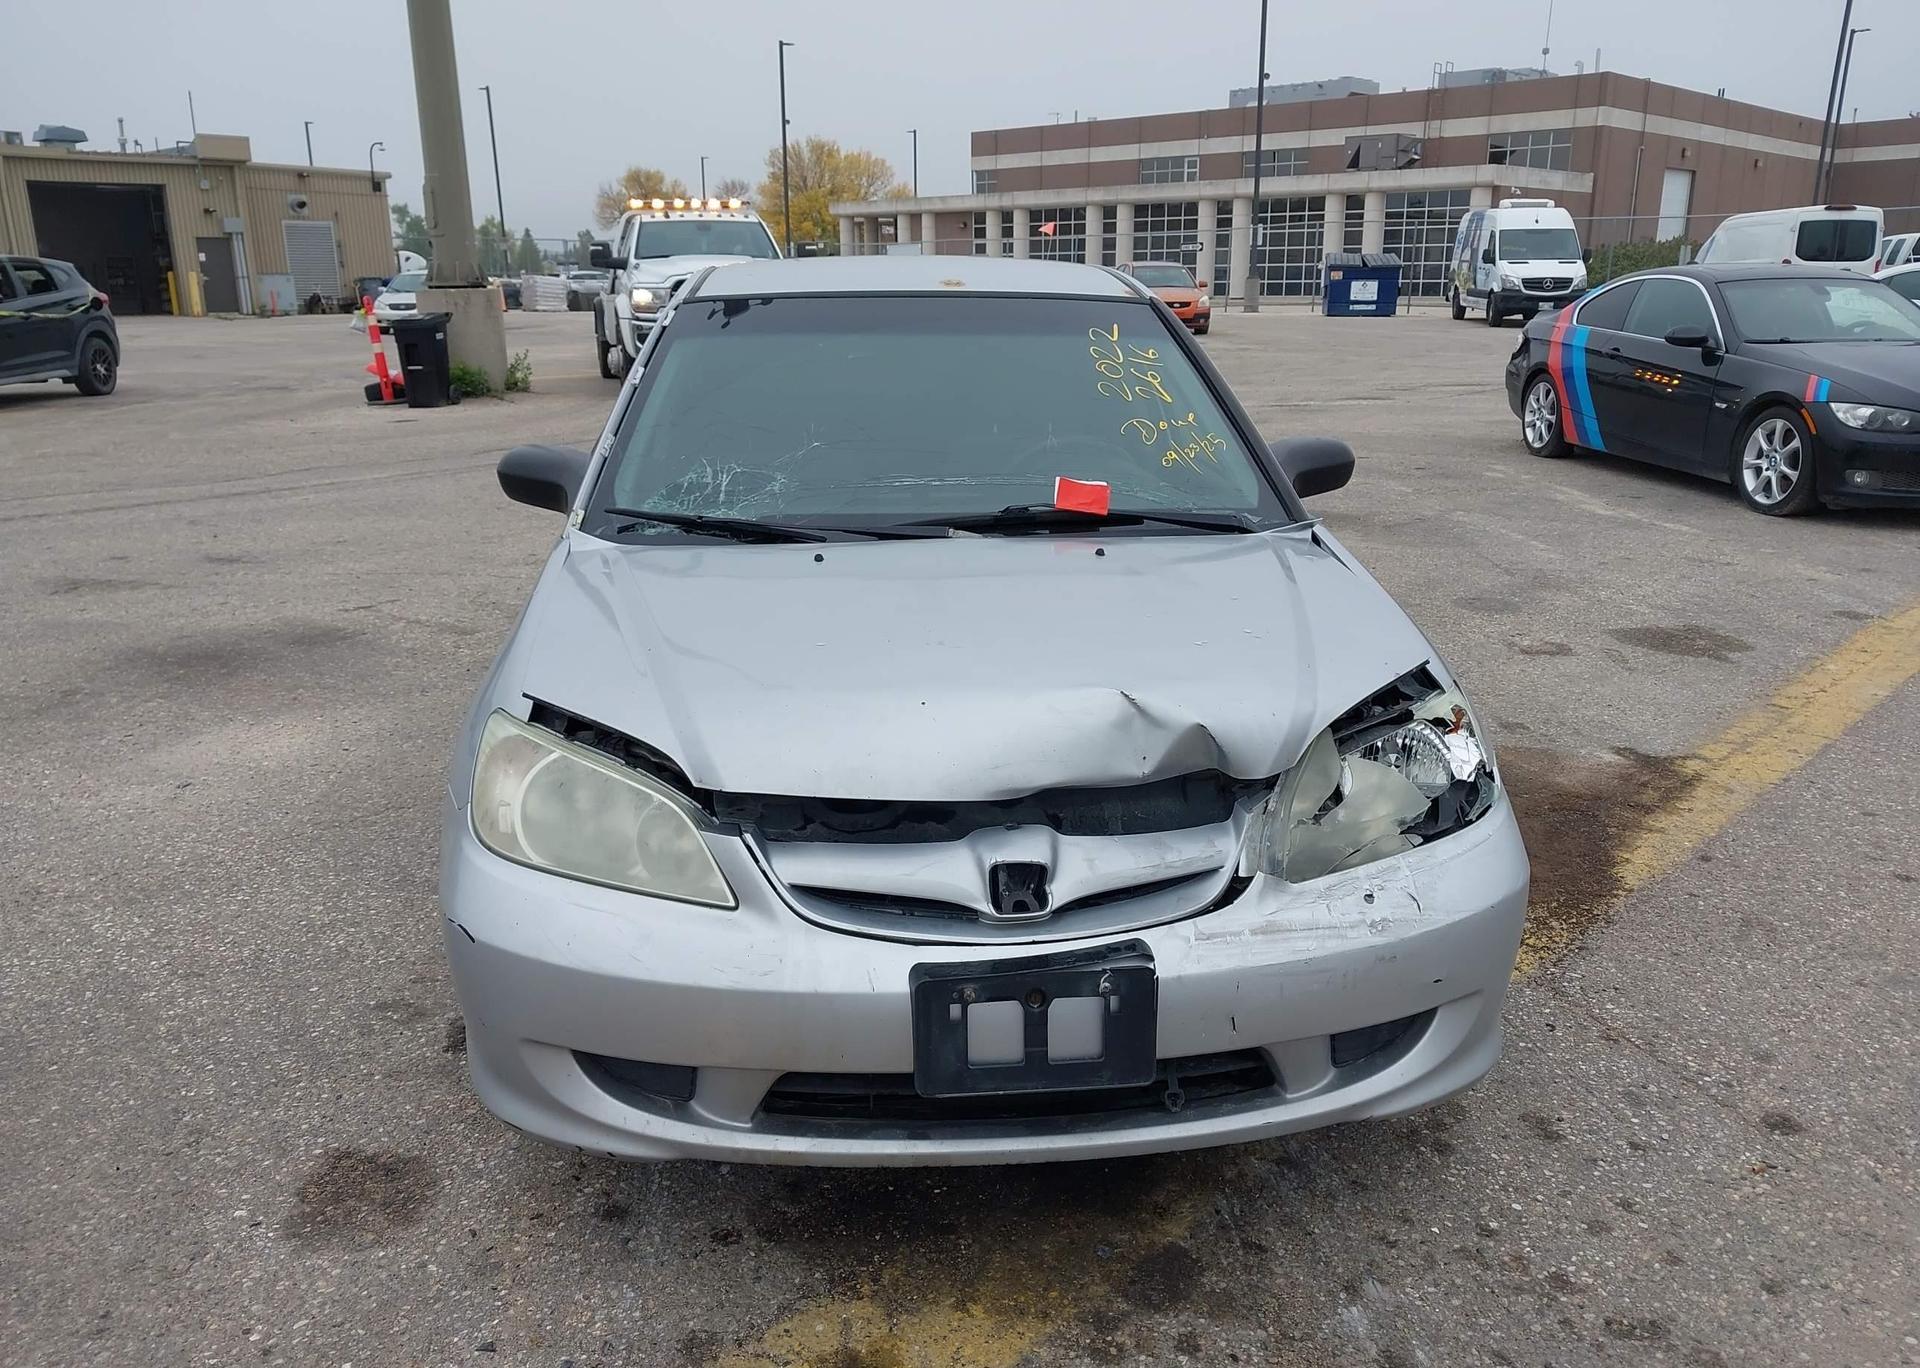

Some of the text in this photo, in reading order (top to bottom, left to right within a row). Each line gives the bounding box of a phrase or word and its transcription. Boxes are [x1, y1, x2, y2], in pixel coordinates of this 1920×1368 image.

[1089, 323, 1132, 401] 2022
[1128, 344, 1173, 403] 2616
[1162, 431, 1226, 475] 09/23/25
